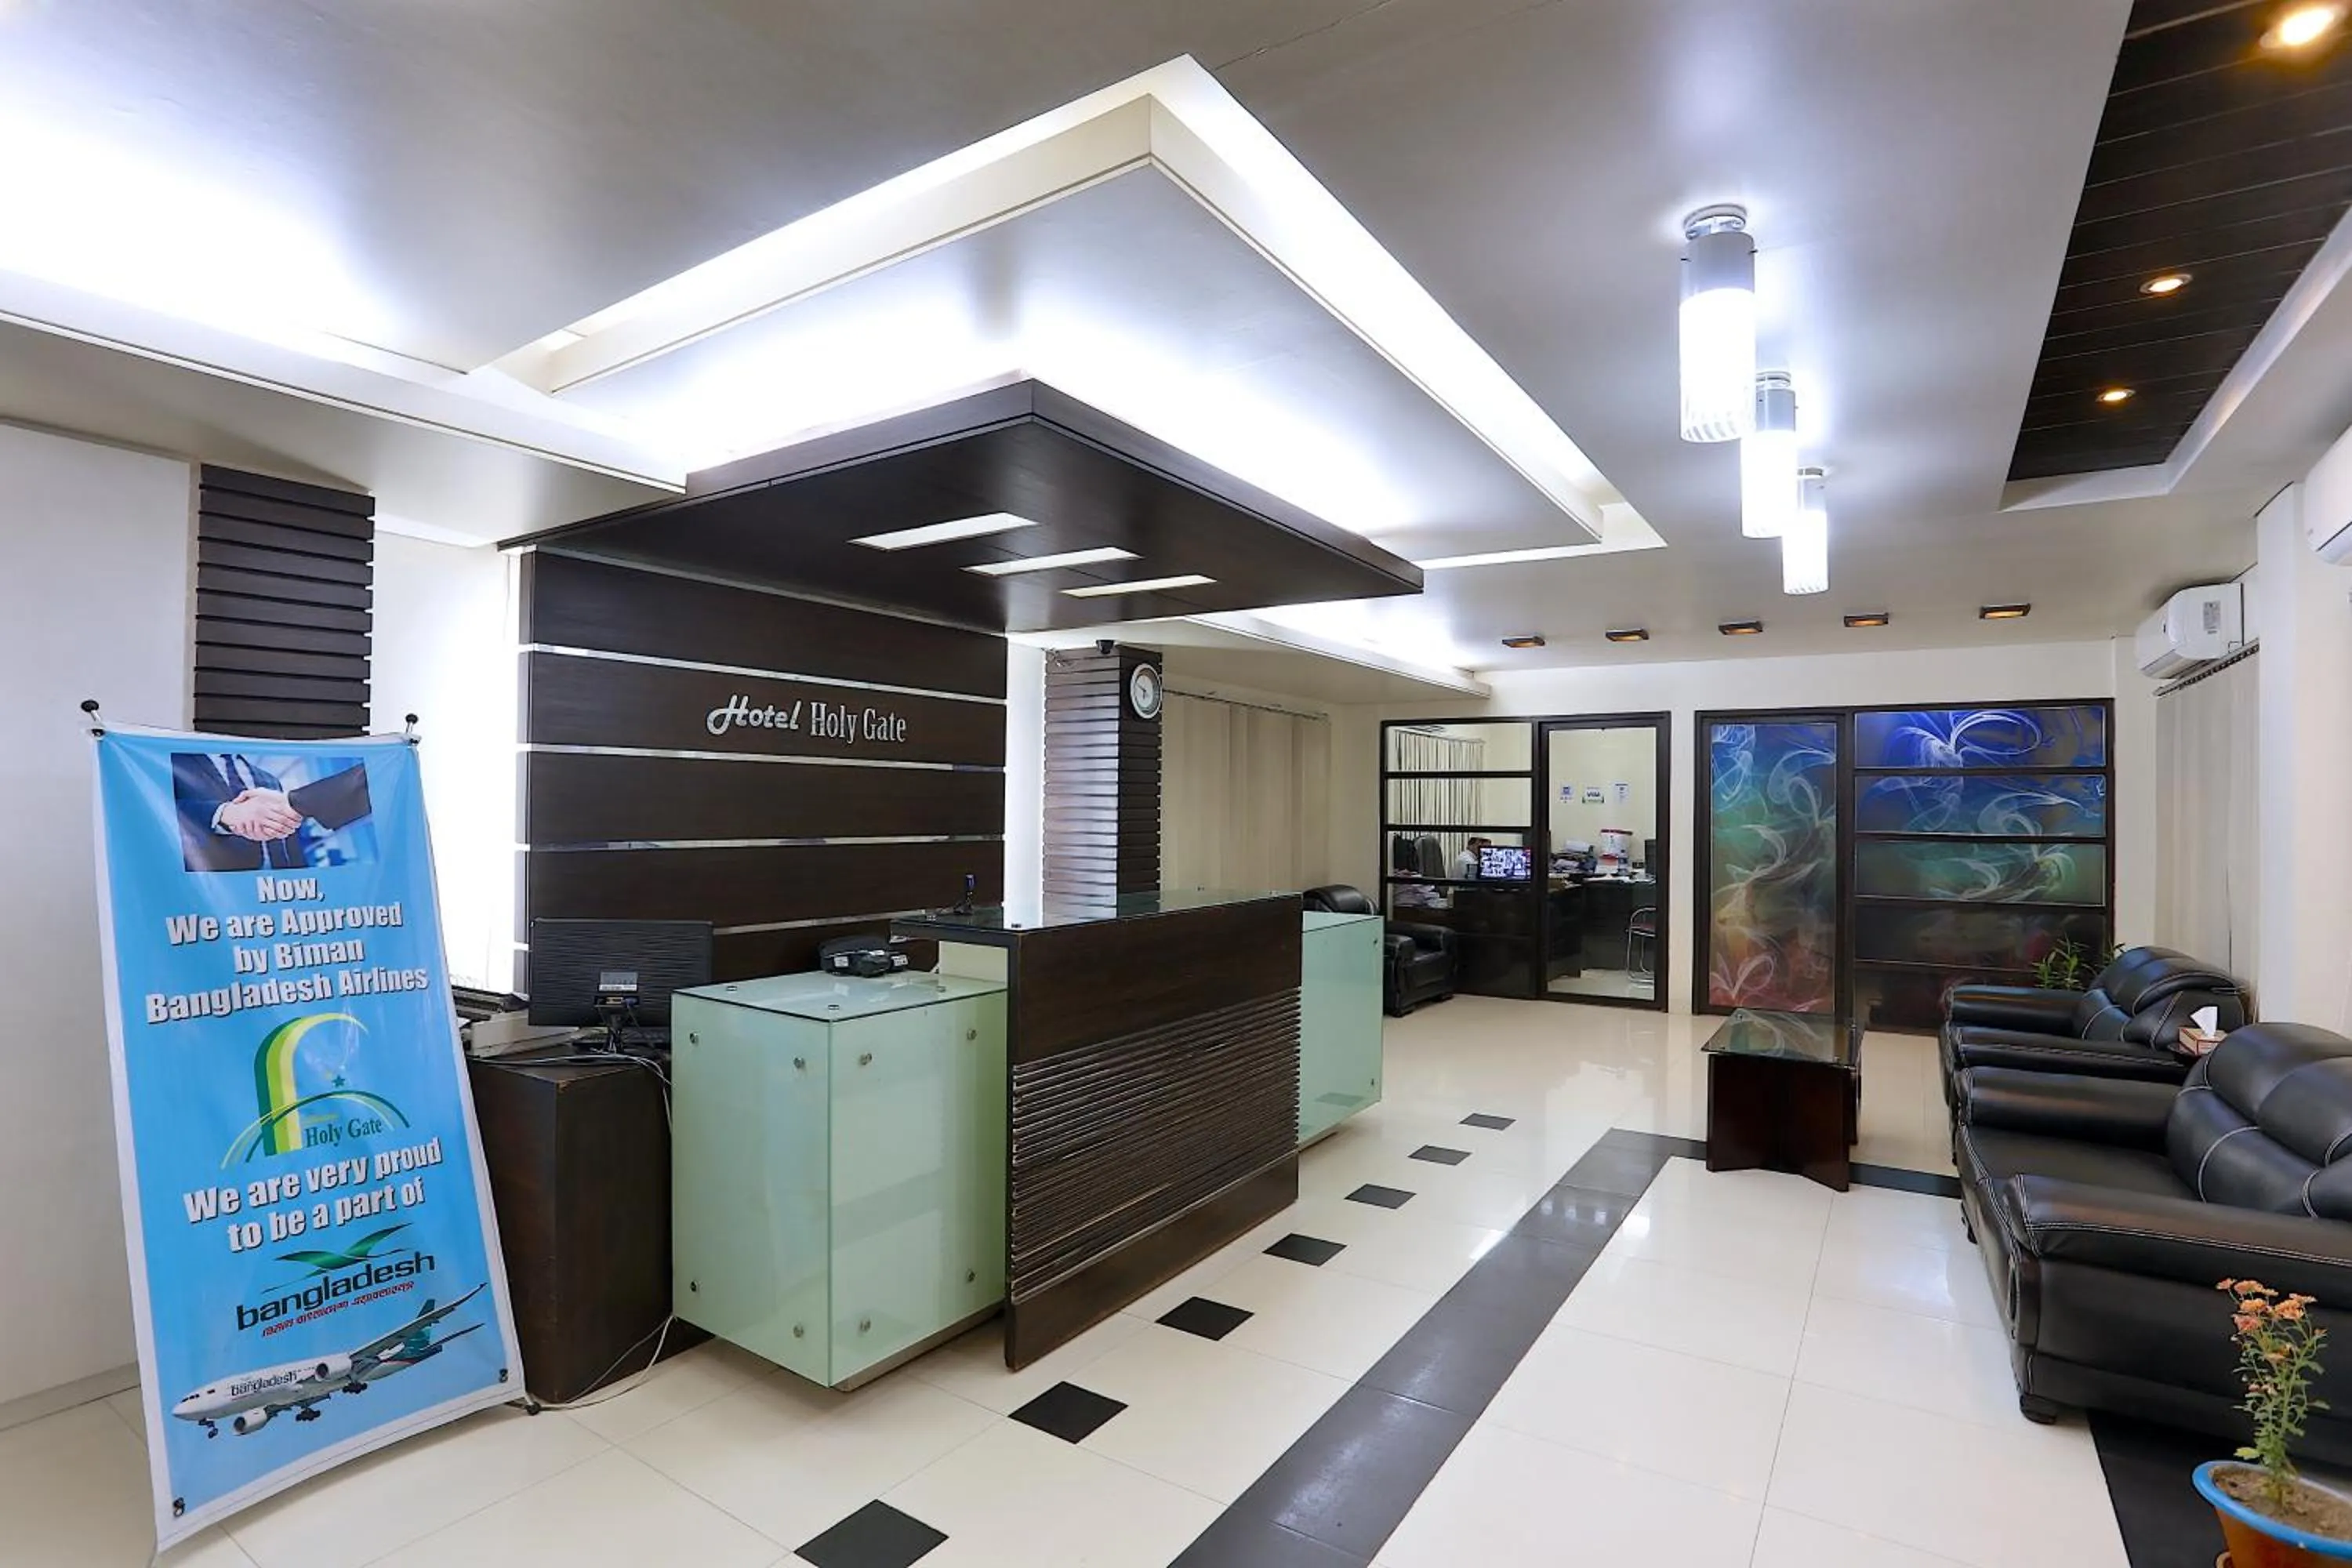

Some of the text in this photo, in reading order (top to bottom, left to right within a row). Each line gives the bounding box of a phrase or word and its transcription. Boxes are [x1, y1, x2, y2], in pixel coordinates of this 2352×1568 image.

[706, 695, 906, 744] Hotel Holy Gate
[257, 877, 325, 903] Now,
[165, 902, 404, 946] We are Approved
[234, 940, 365, 974] by Biman
[146, 967, 430, 1023] Bangladesh Airlines
[305, 1116, 382, 1147] Holy Gate
[183, 1137, 443, 1224] We are very proud
[227, 1177, 426, 1253] to be a part of
[237, 1251, 435, 1331] bangladesh
[230, 1370, 297, 1396] bangladesh
